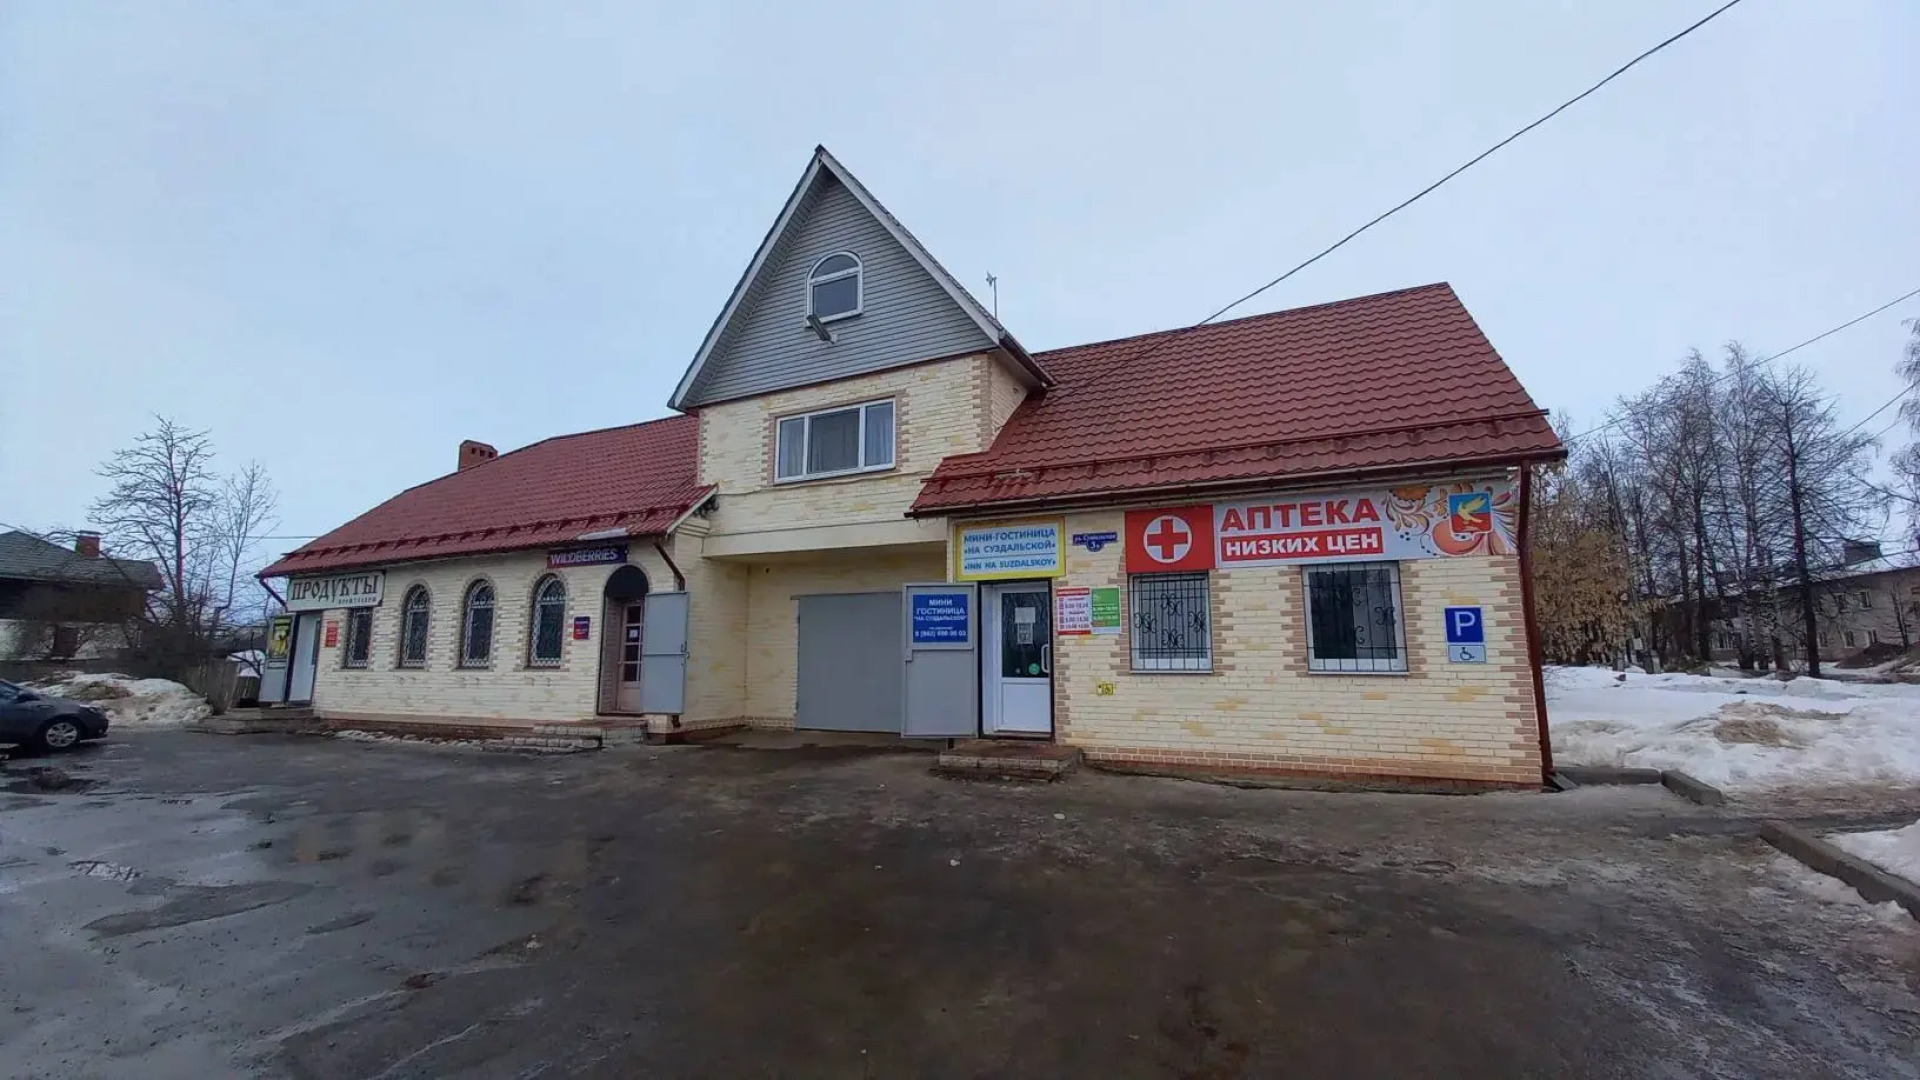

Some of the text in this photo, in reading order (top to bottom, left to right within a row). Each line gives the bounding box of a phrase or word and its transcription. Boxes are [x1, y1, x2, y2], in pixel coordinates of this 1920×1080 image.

[1220, 498, 1381, 532] АПТЕКА
[964, 528, 1056, 544] МИНИ-ГОСТИНИЦА
[1226, 533, 1379, 557] НИЗКИХ ЦЕН
[551, 548, 618, 564] WILDBERRIES
[985, 561, 997, 569] NA
[291, 575, 380, 602] ПРОДУКТЫ
[928, 598, 953, 607] МИНИ
[916, 607, 966, 615] ГОСТИНИЦА
[1454, 611, 1476, 637] P
